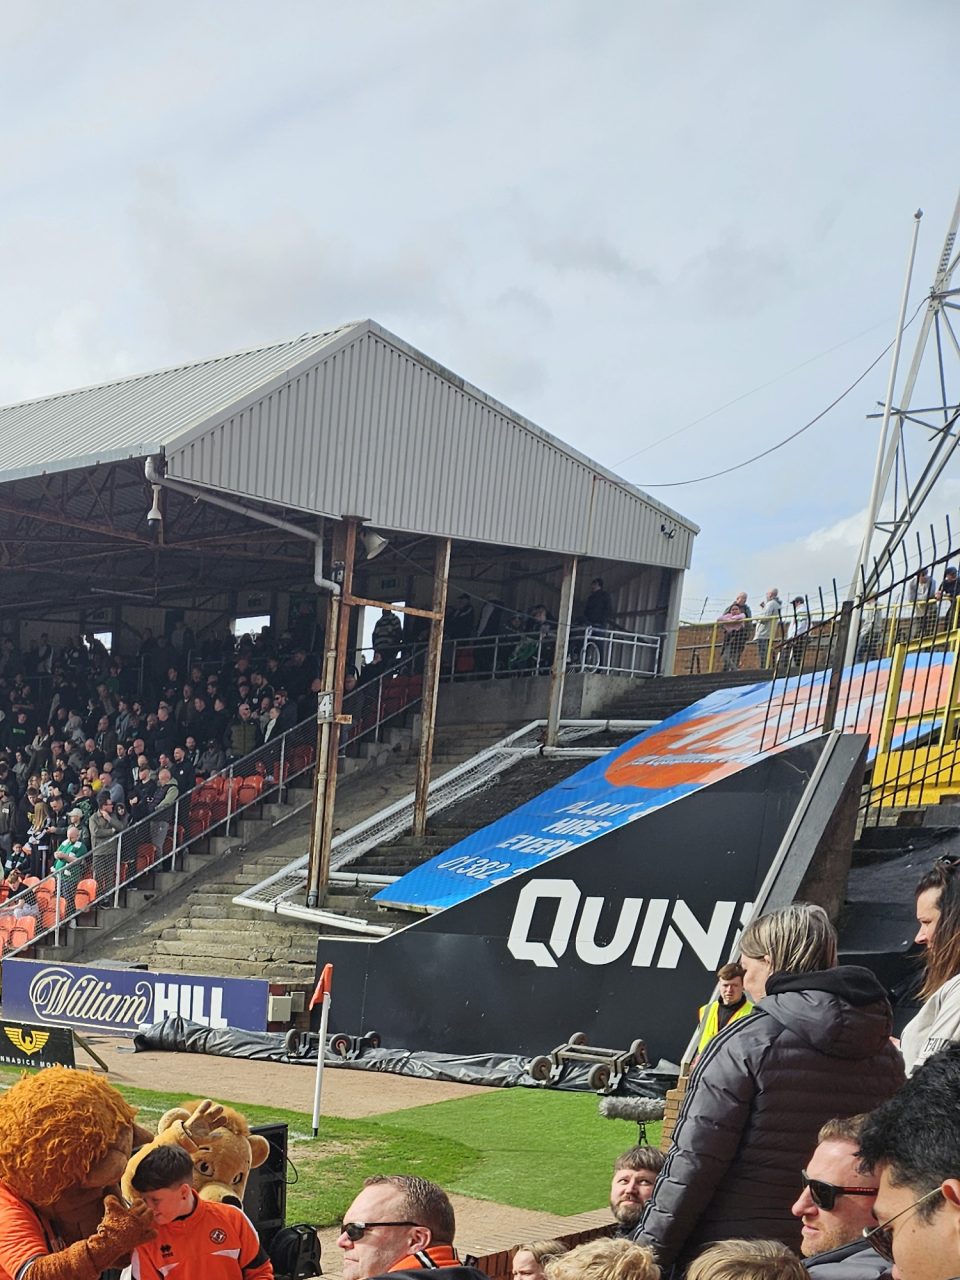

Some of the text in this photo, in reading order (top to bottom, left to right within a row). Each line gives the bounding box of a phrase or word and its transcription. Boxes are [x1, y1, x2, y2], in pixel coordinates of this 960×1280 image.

[319, 694, 333, 718] 4
[541, 817, 613, 837] HIRE
[437, 855, 511, 880] 01382
[29, 967, 228, 1031] William HILL
